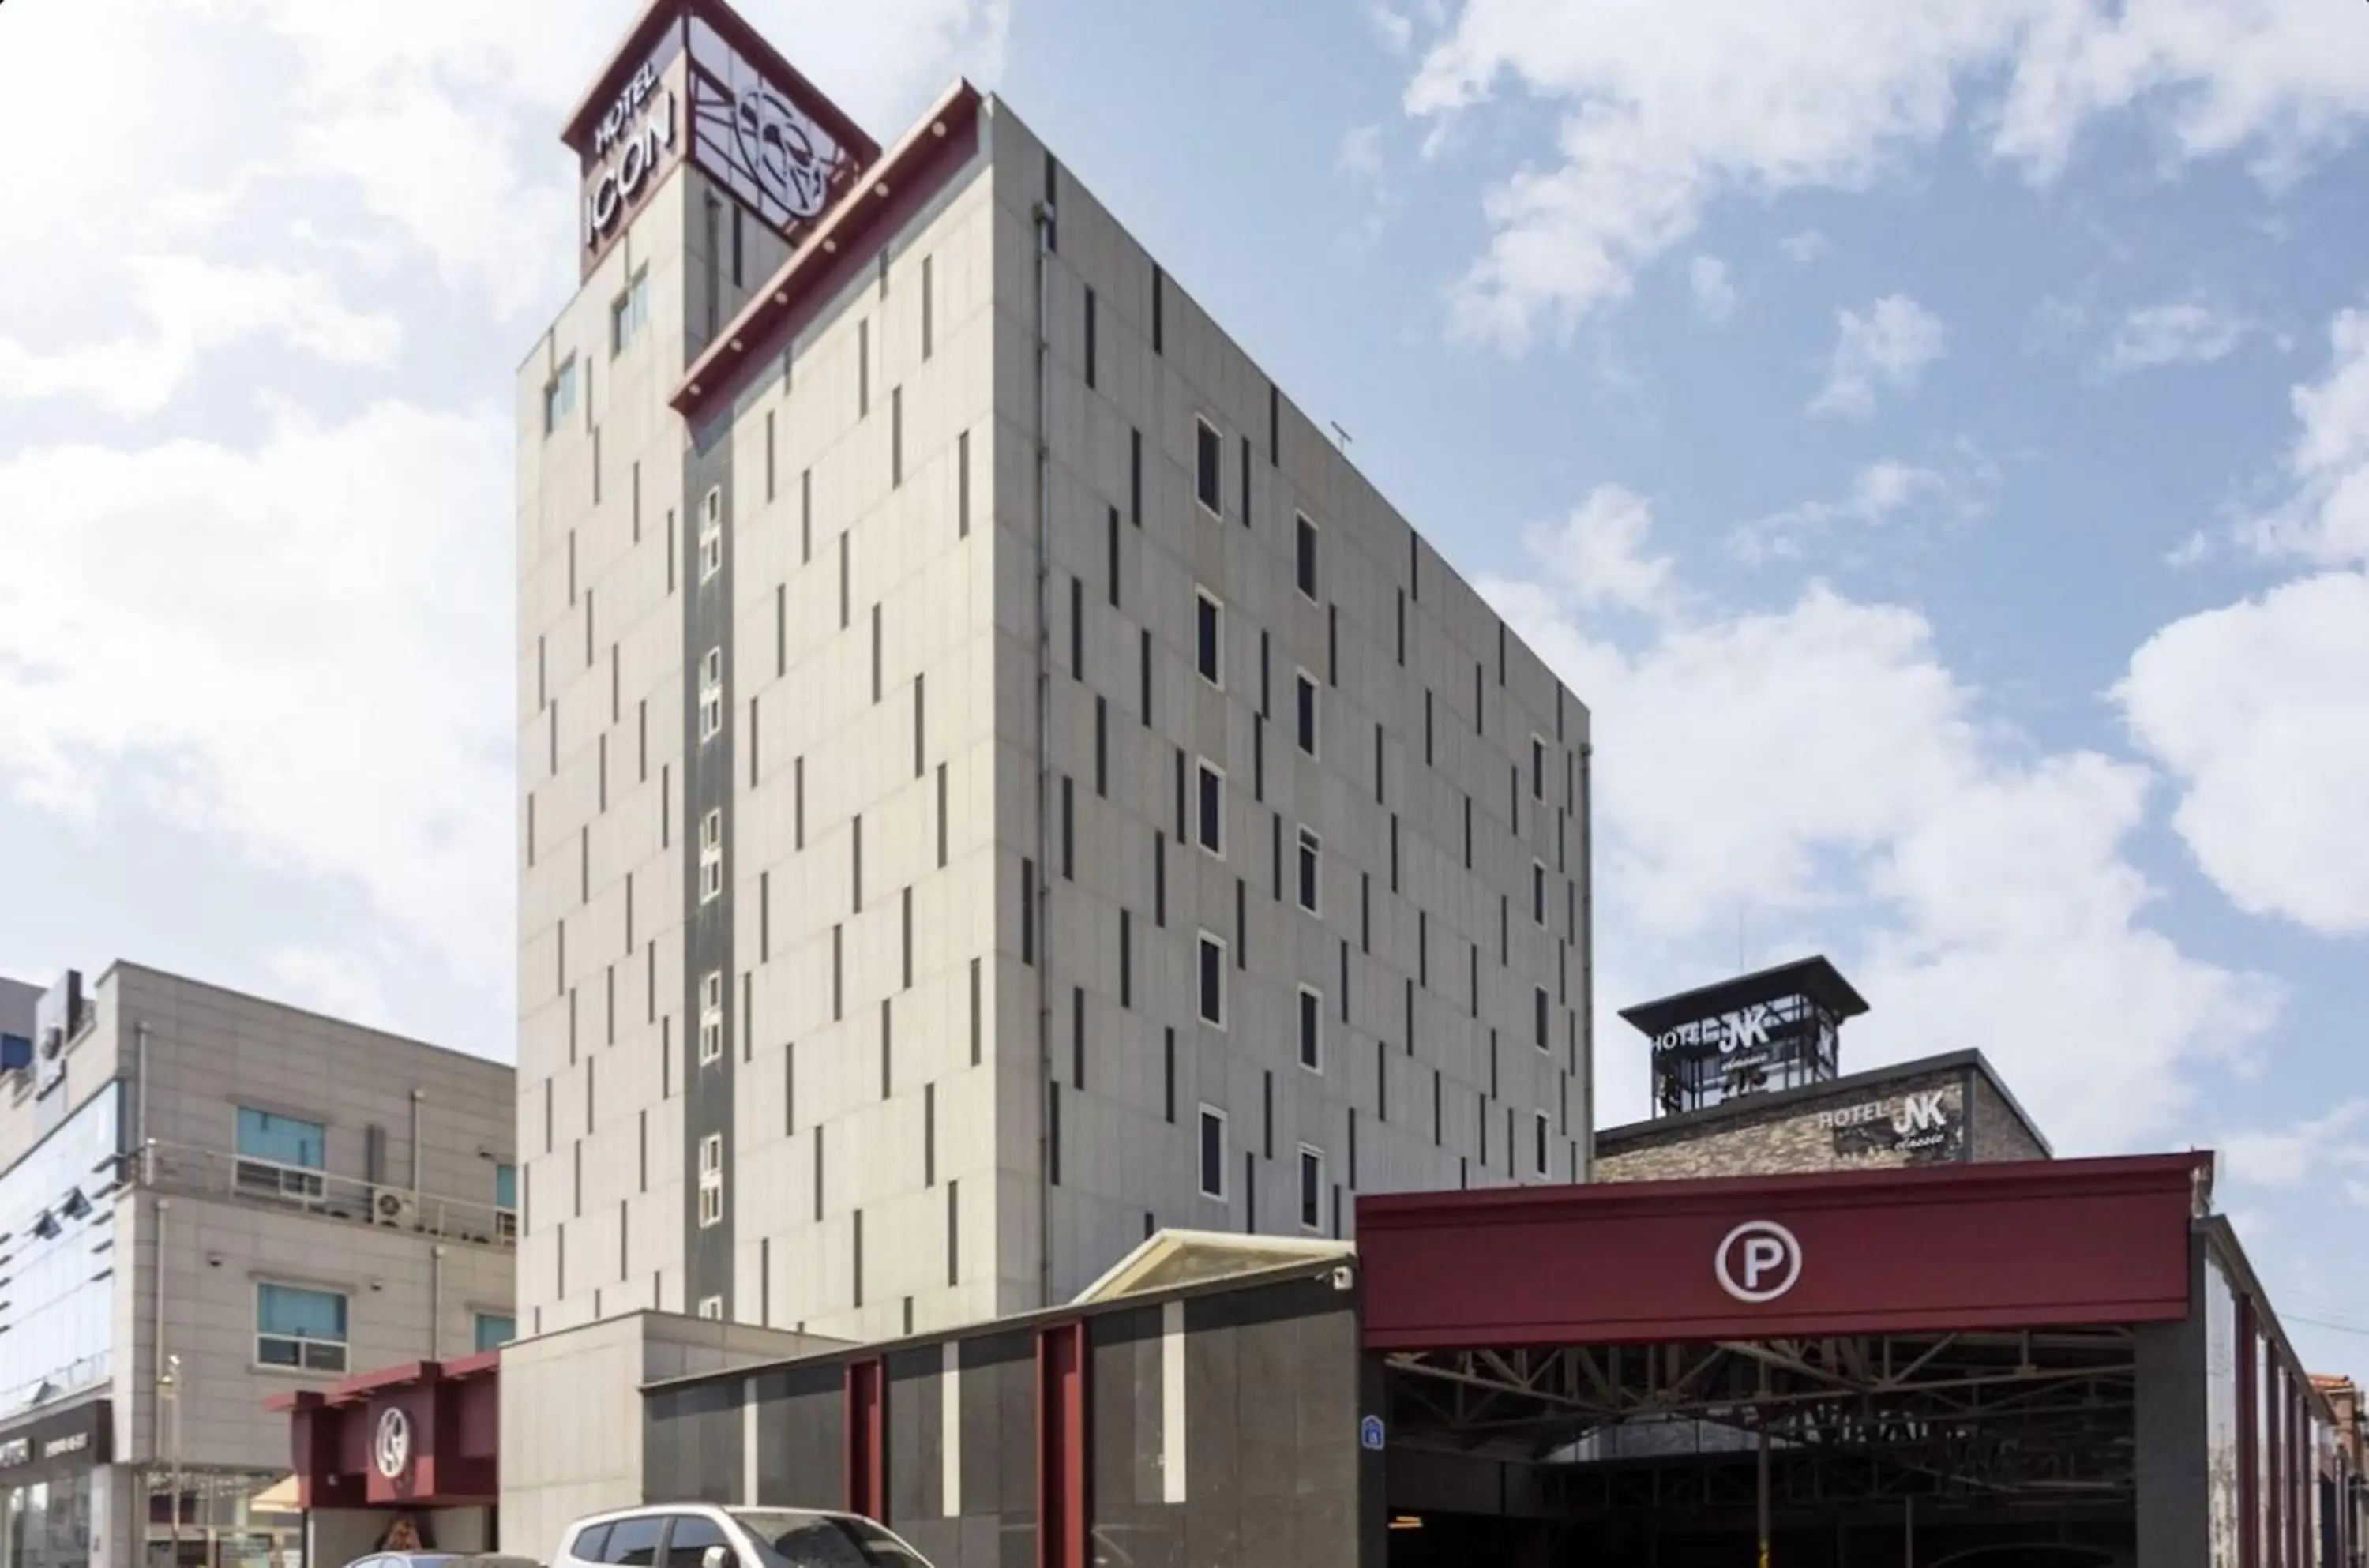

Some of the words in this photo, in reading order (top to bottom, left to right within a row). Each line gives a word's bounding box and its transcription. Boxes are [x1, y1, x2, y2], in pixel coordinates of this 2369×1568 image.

[595, 62, 656, 154] HOTEL
[585, 91, 670, 246] ICON
[1652, 1017, 1720, 1052] HOTEL
[1819, 1101, 1886, 1130] HOTEL
[1744, 1237, 1785, 1288] P
